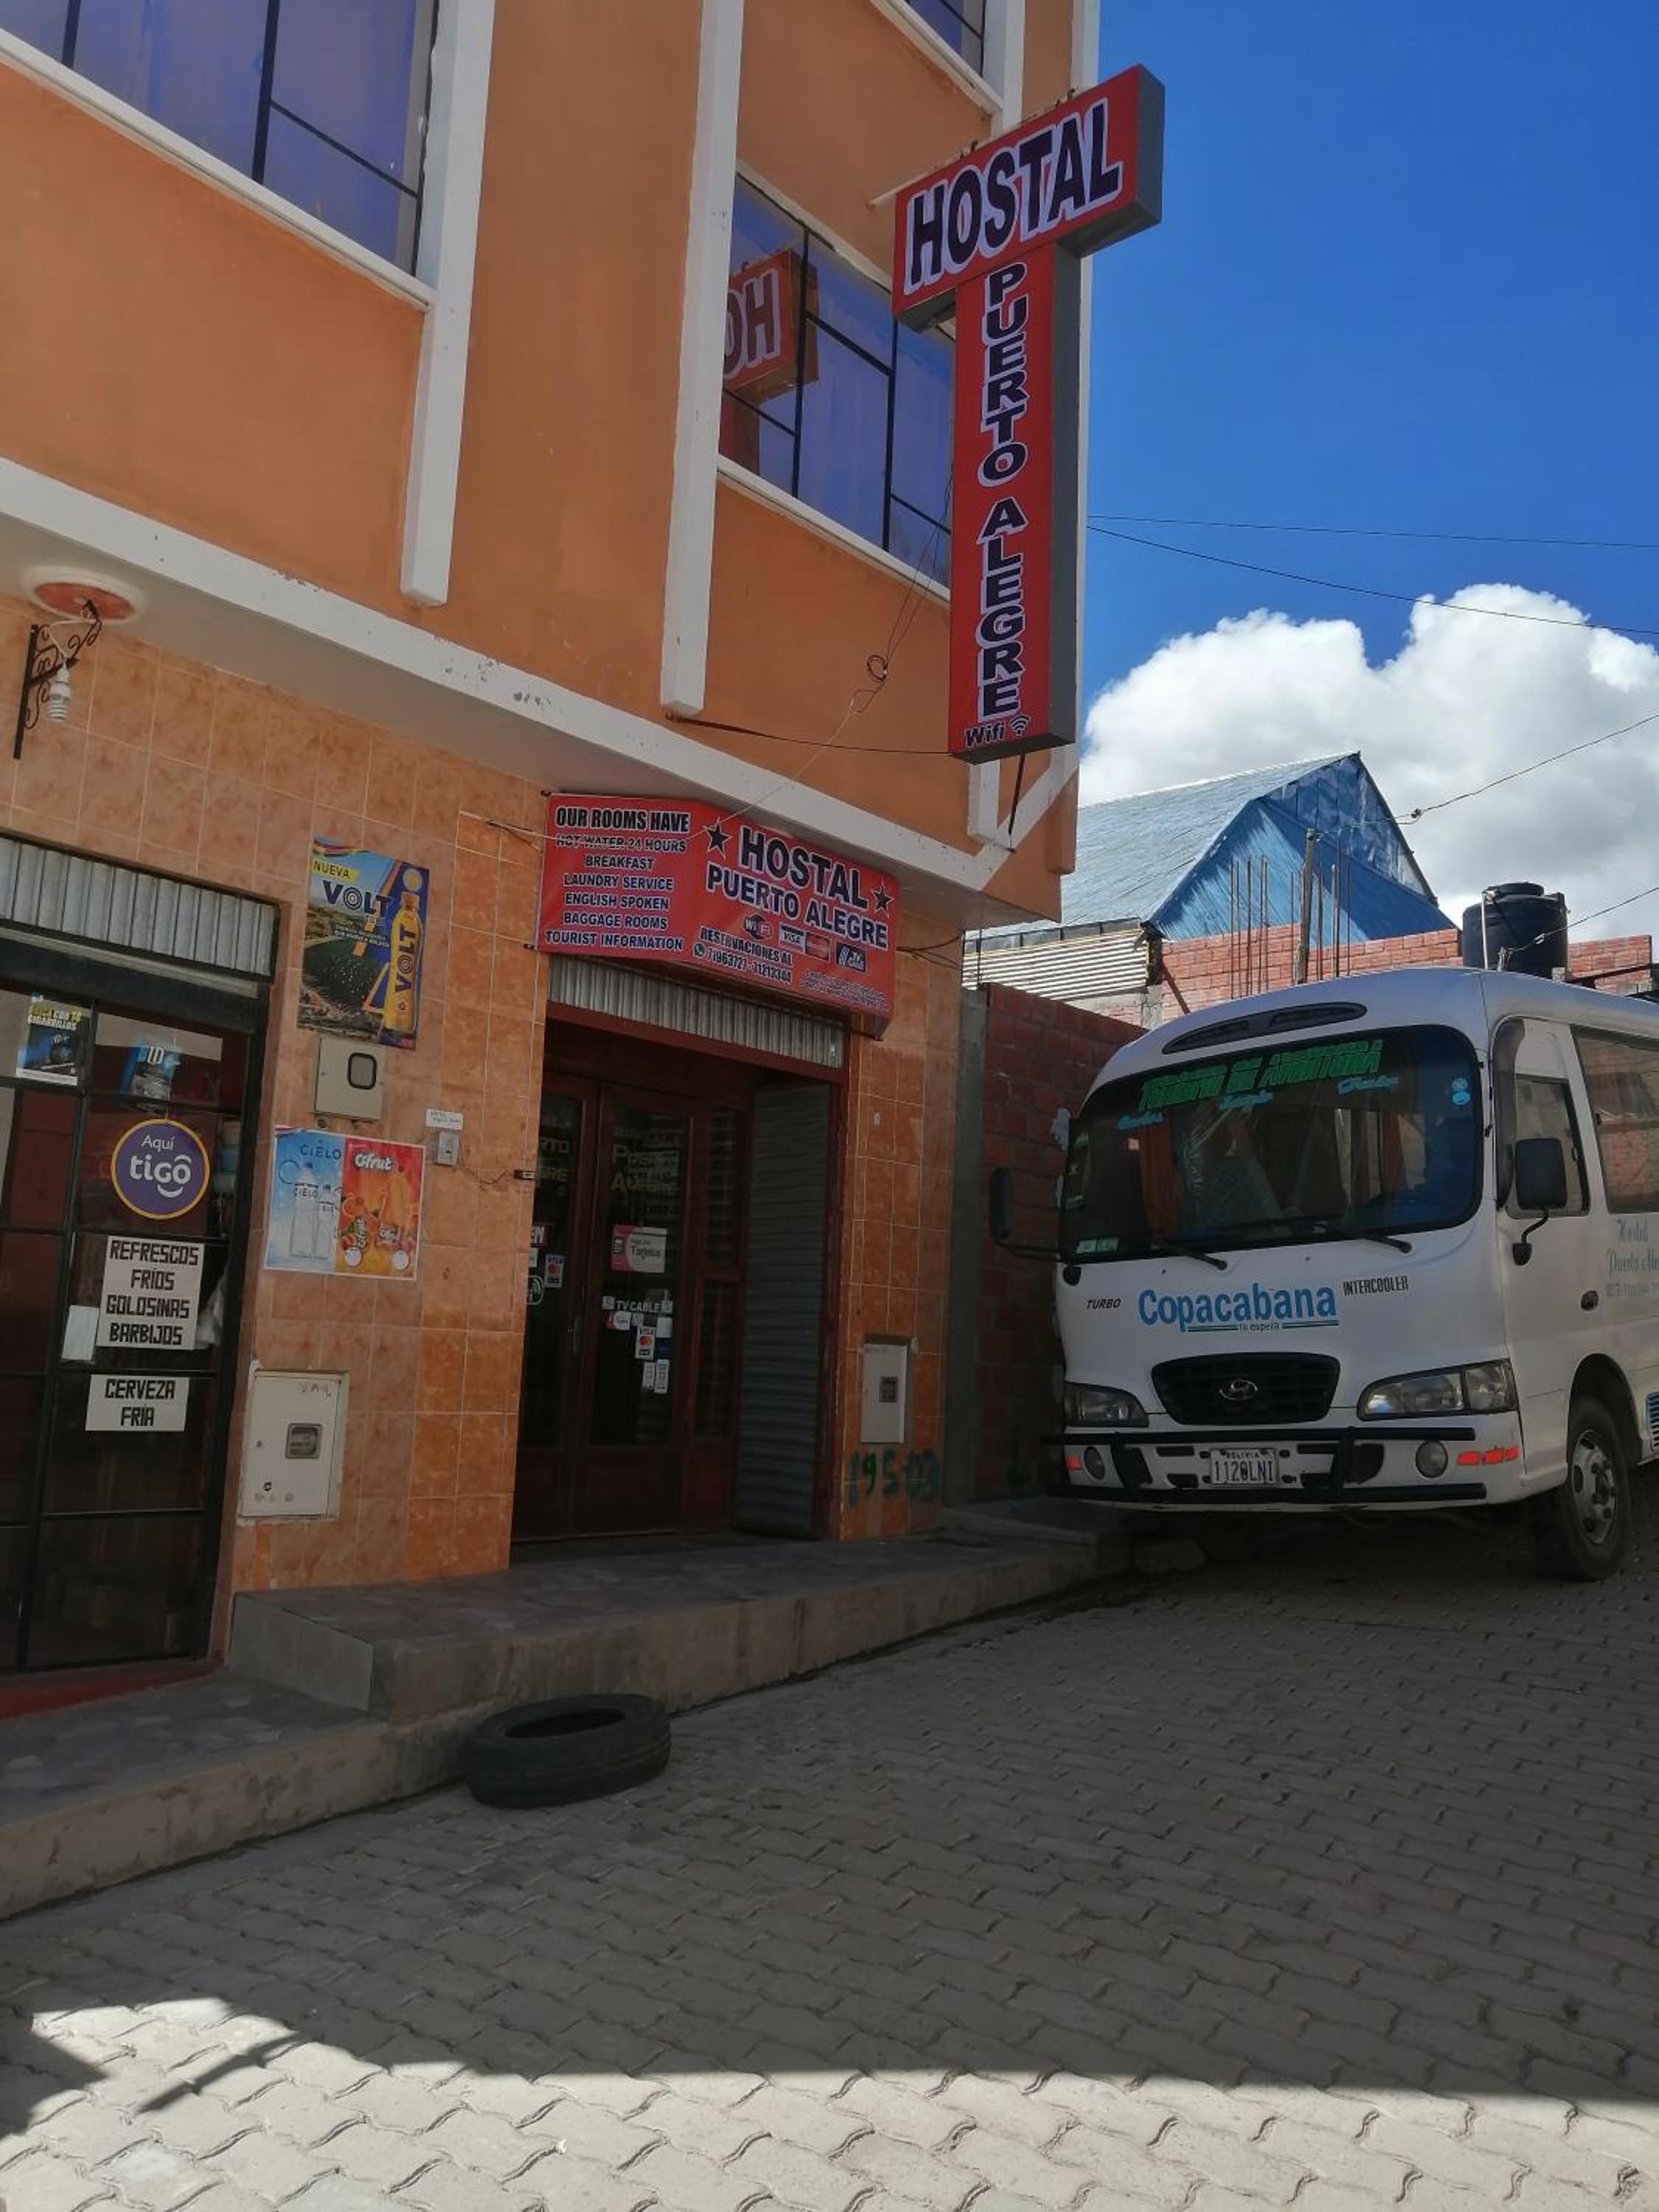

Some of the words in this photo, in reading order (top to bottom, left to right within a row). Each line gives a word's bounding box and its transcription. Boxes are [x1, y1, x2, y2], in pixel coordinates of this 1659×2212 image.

[903, 97, 1123, 296] HOSTAL
[978, 262, 1030, 487] PUERTO
[975, 496, 1029, 723] ALEGRE
[964, 721, 1006, 748] Wifi
[556, 807, 588, 828] OUR
[591, 809, 648, 831] ROOMS
[650, 811, 690, 834] HAVE
[644, 839, 687, 853] HOURS
[313, 860, 351, 879] NUEVA
[585, 855, 655, 870] BREAKFAST
[739, 824, 869, 911] HOSTAL
[563, 873, 619, 888] LAUNDRY
[622, 876, 674, 891] SERVICE
[323, 880, 392, 916] VOLT
[565, 893, 619, 906] ENGLISH
[620, 896, 669, 910] SPOKEN
[706, 860, 801, 921] PUERTO
[803, 898, 889, 951] ALEGRE
[563, 912, 622, 928] BAGGAGE
[625, 915, 667, 930] ROOMS
[546, 931, 597, 945] TOURIST
[601, 933, 684, 951] INFORMATION
[700, 926, 780, 963] RESERVACIONES
[395, 924, 416, 992] VOLT
[142, 1135, 175, 1152] Aquí
[129, 1154, 192, 1186] tigo
[354, 1152, 393, 1171] Cifrut
[110, 1240, 200, 1266] REFRESCOS
[1343, 1276, 1409, 1296] INTERCOOLER
[106, 1294, 191, 1318] GOLOSINAS
[616, 1300, 629, 1311] TV
[1086, 1298, 1121, 1310] TURBO
[1138, 1282, 1337, 1332] Copacabana
[109, 1323, 184, 1346] BARBIJOS
[105, 1379, 176, 1400] CERVEZA
